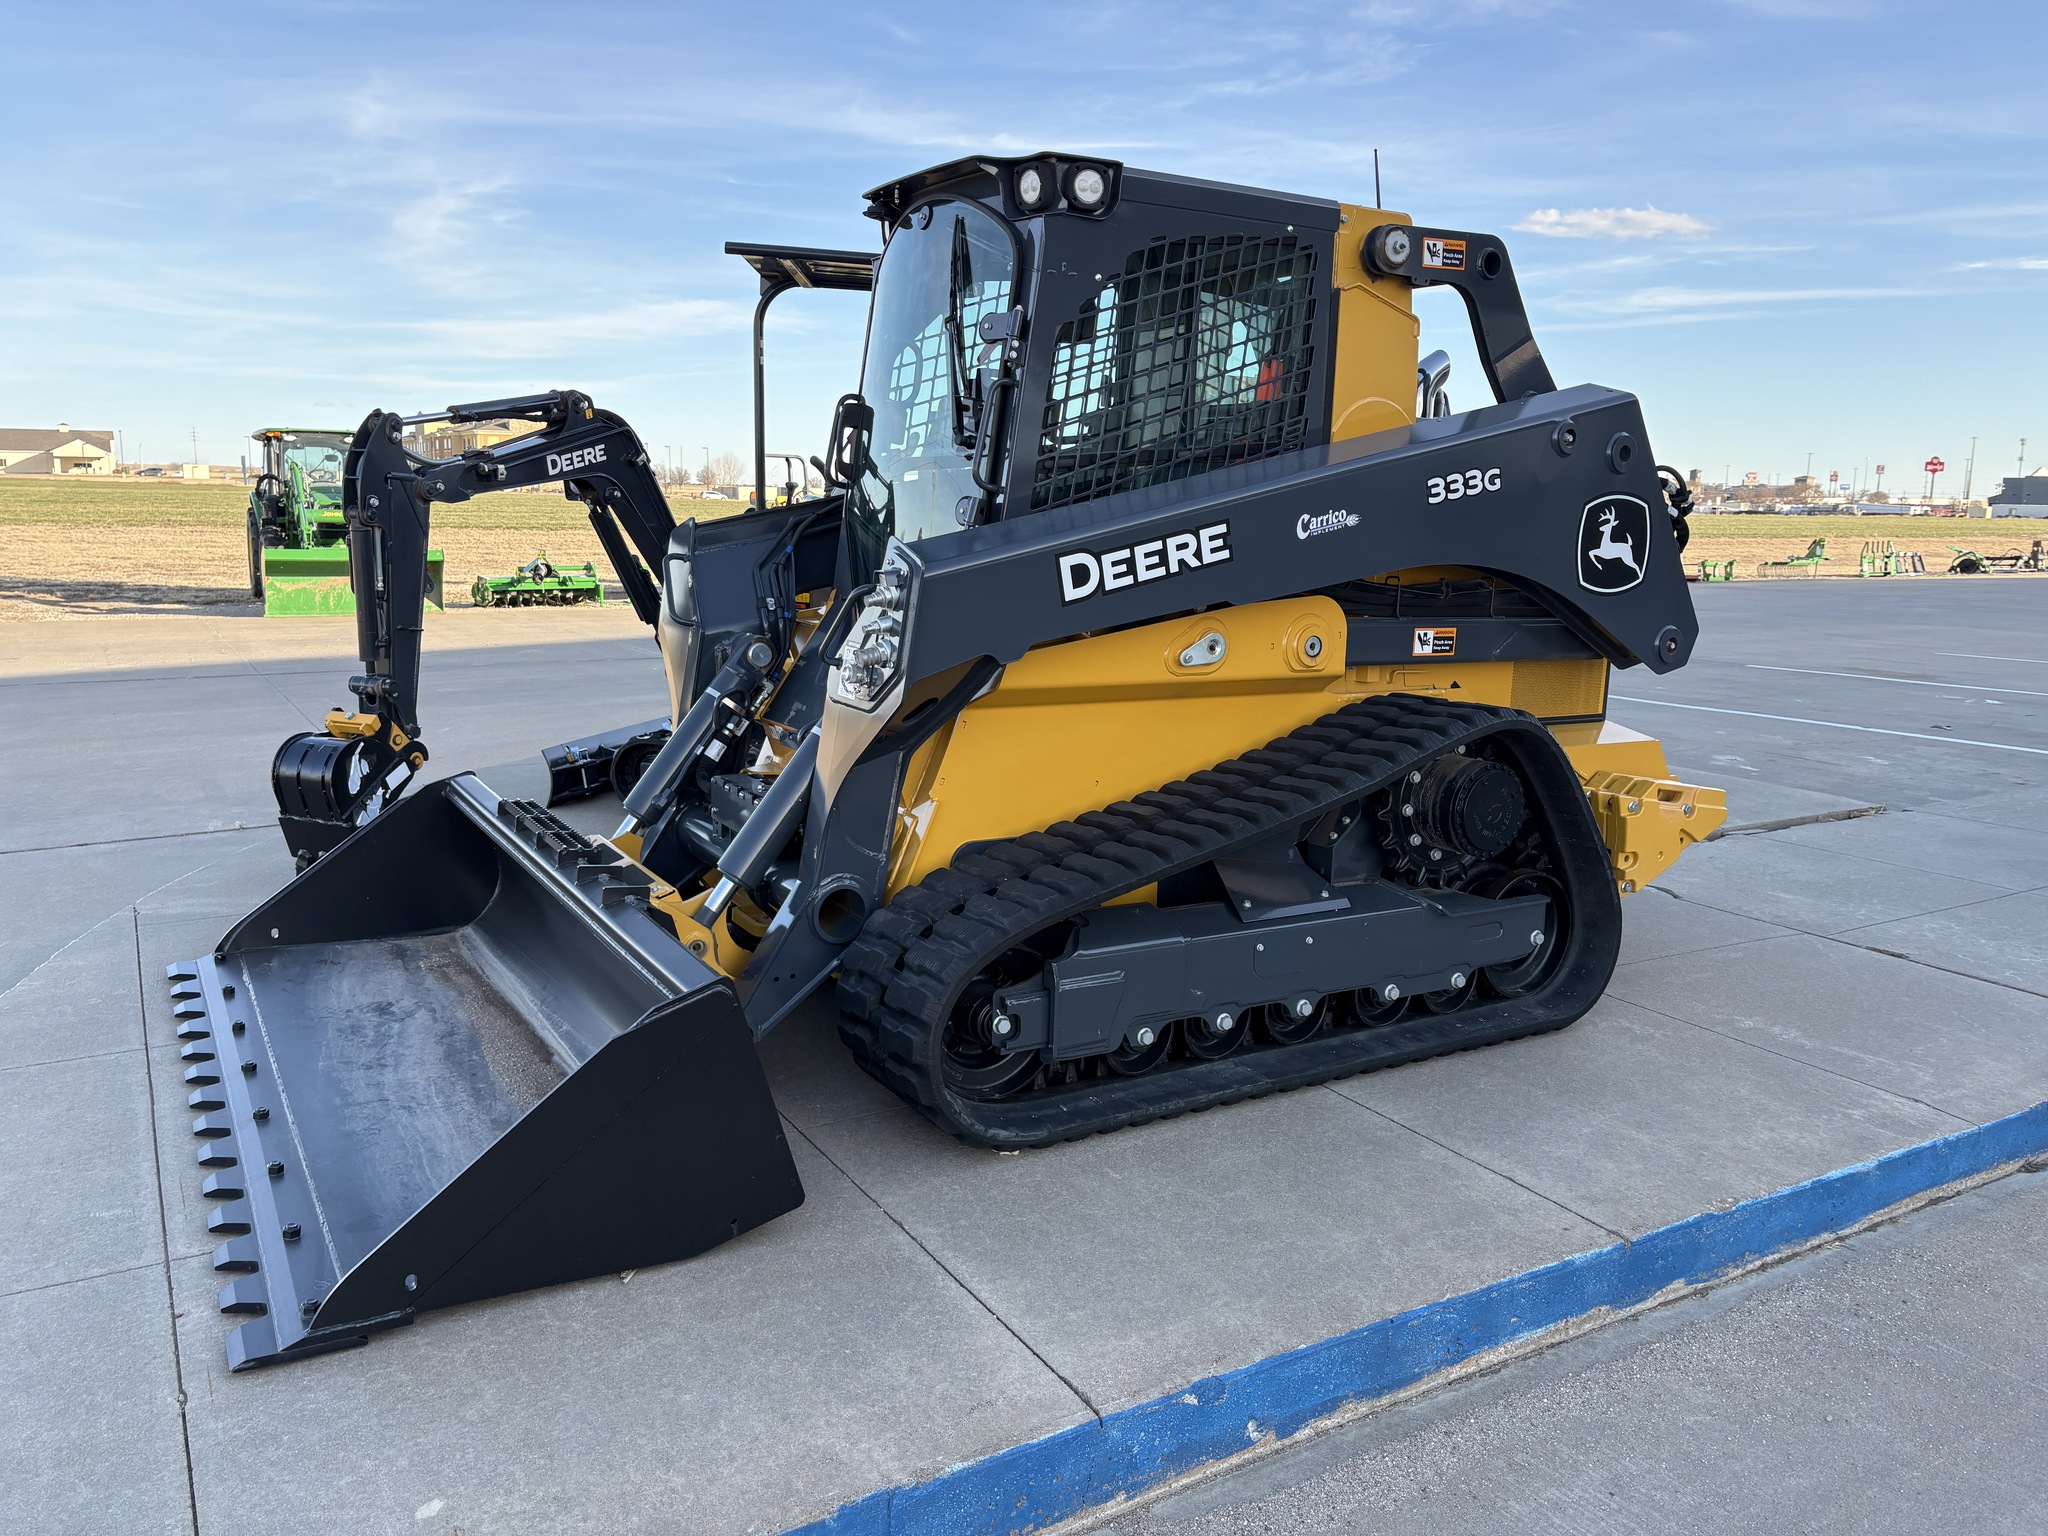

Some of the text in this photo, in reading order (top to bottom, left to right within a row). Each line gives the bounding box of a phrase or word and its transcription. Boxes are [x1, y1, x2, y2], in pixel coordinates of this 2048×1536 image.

[546, 444, 607, 476] DEERE
[1427, 468, 1501, 504] 333G
[1296, 509, 1347, 540] Carrico
[1310, 523, 1346, 537] IMPLEMENT
[1059, 523, 1231, 602] DEERE
